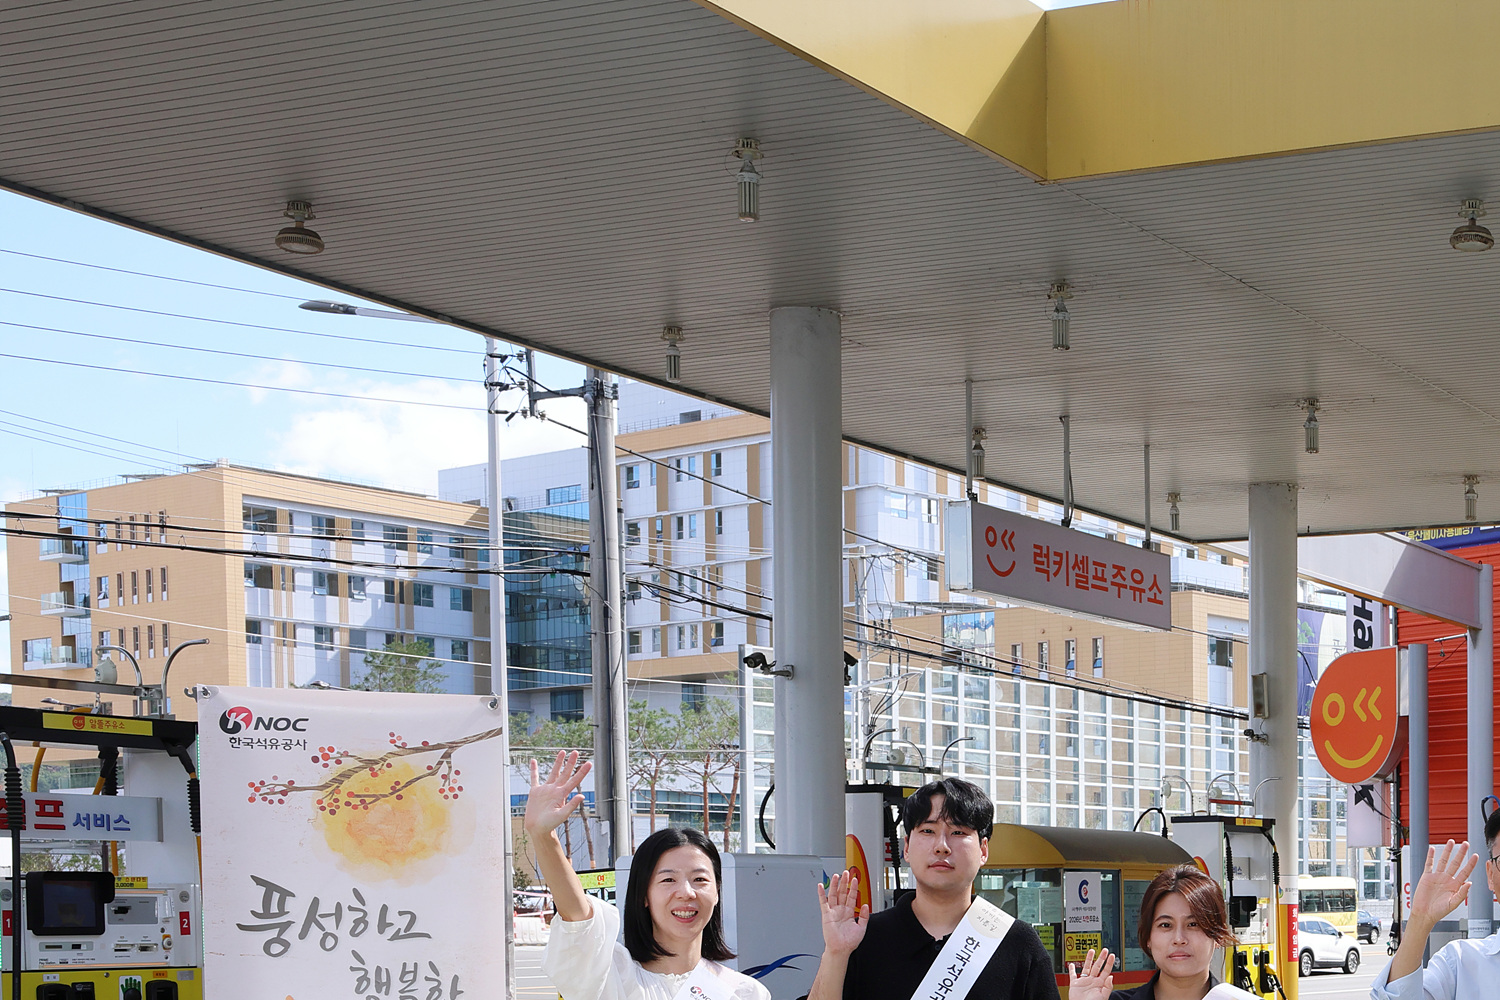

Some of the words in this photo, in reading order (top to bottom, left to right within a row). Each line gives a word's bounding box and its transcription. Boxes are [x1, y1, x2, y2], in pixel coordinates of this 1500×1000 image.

[1033, 542, 1164, 606] 럭키셀프주유소
[89, 718, 125, 730] 알뜰주유소
[219, 706, 309, 734] KNOC
[229, 737, 307, 751] 한국석유공사
[72, 812, 131, 831] 서비스
[6, 918, 11, 928] 1
[236, 874, 431, 958] 풍성하고
[182, 919, 188, 928] 2
[1075, 938, 1098, 950] 금연구역
